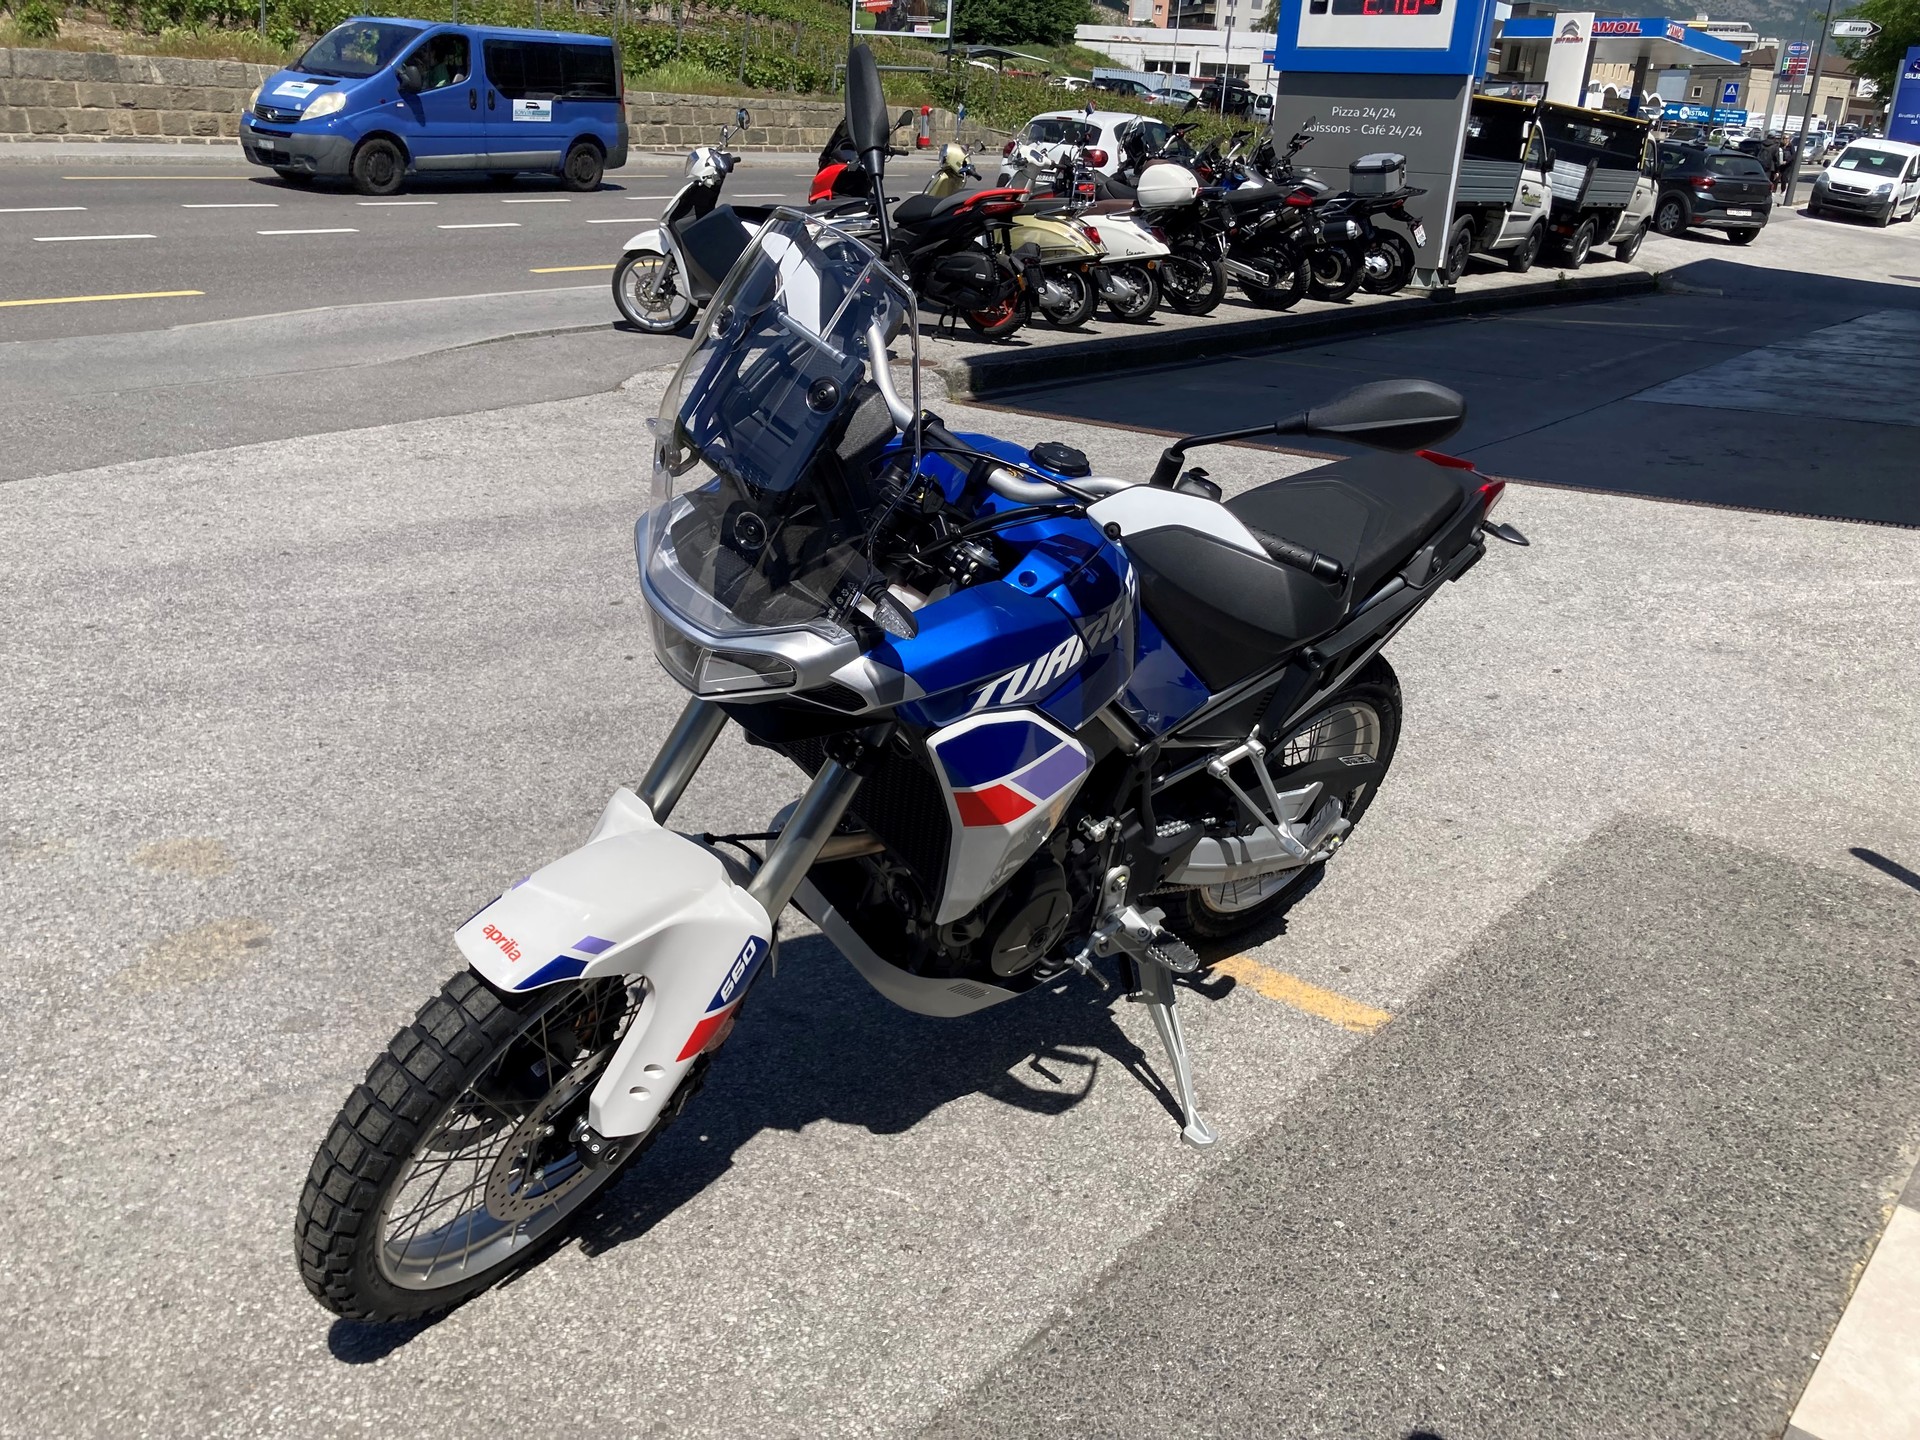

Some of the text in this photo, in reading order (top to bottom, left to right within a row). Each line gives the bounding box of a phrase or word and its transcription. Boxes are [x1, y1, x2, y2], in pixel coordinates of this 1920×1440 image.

[1591, 21, 1643, 34] AMOIL
[1849, 25, 1867, 33] Lavage
[1331, 106, 1396, 120] Pizza 24/24
[1361, 124, 1386, 136] Café
[1388, 125, 1423, 138] 24/24
[482, 923, 522, 963] aprilia
[720, 939, 757, 1002] 660
